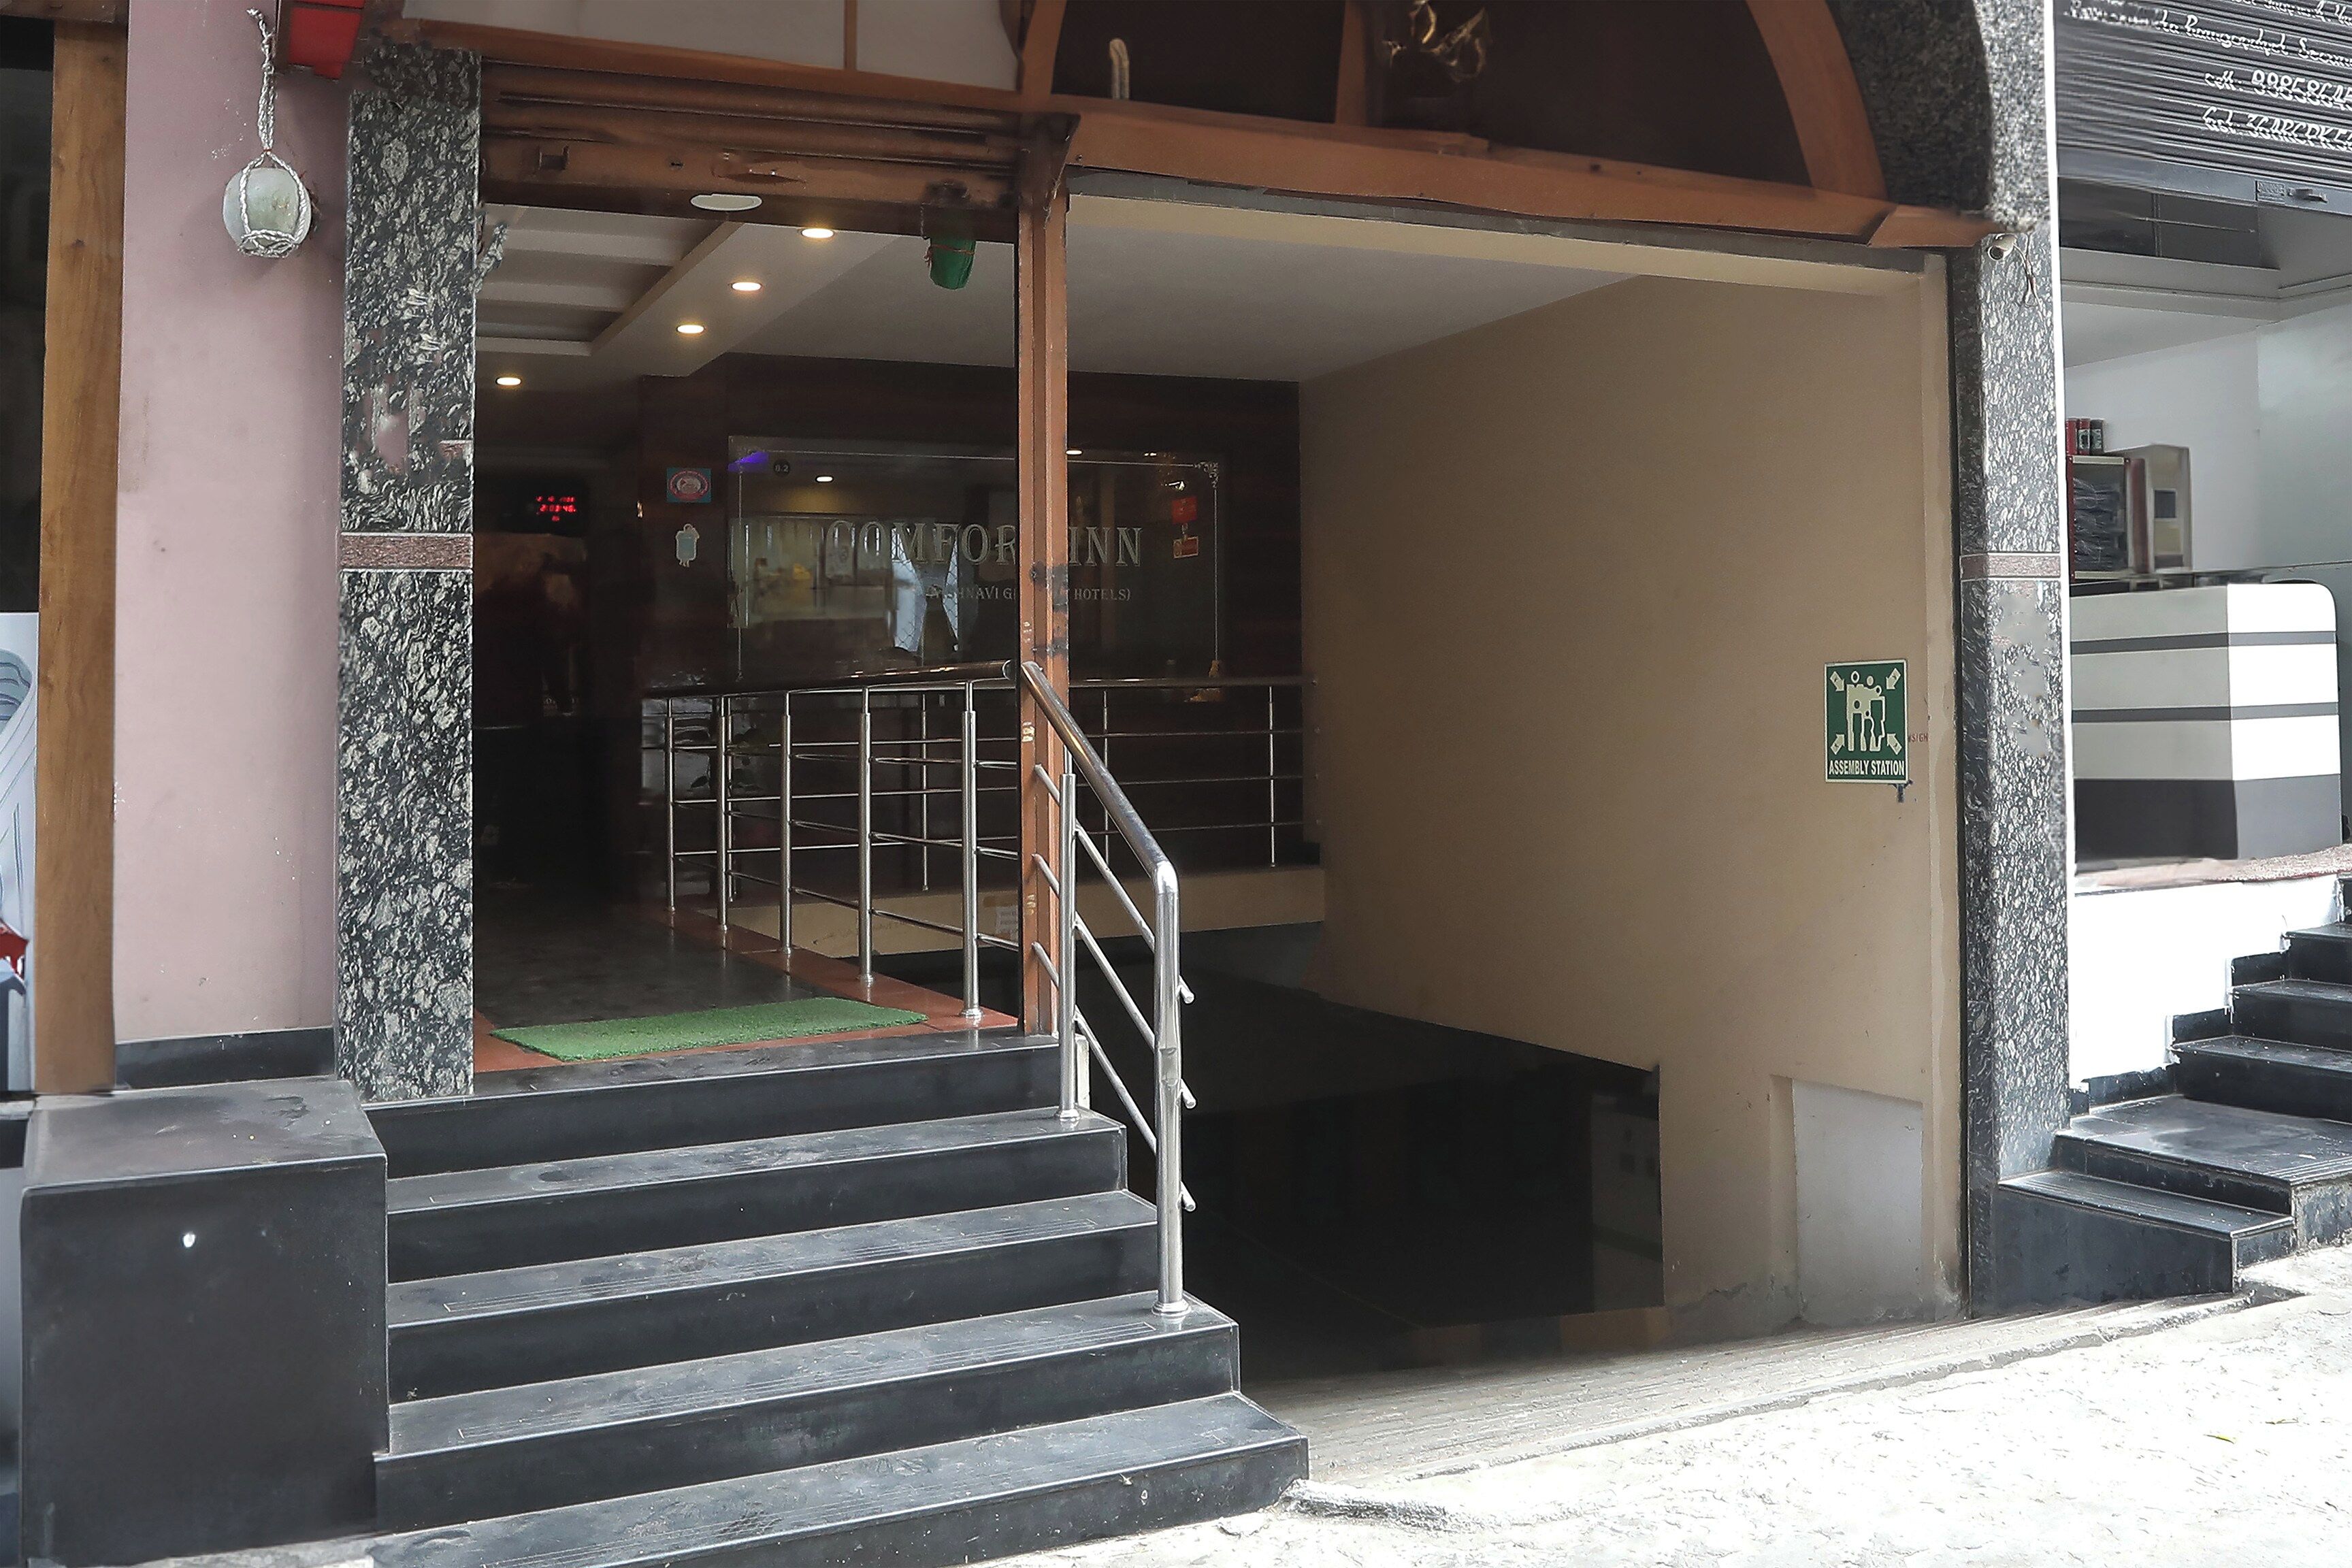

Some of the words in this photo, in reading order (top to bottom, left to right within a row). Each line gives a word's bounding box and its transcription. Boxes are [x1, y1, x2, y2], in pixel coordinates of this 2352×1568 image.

[826, 519, 1017, 566] COMFOR
[1068, 525, 1145, 568] INN
[1829, 760, 1869, 775] ASSEMBLY
[1871, 760, 1905, 776] STATION
